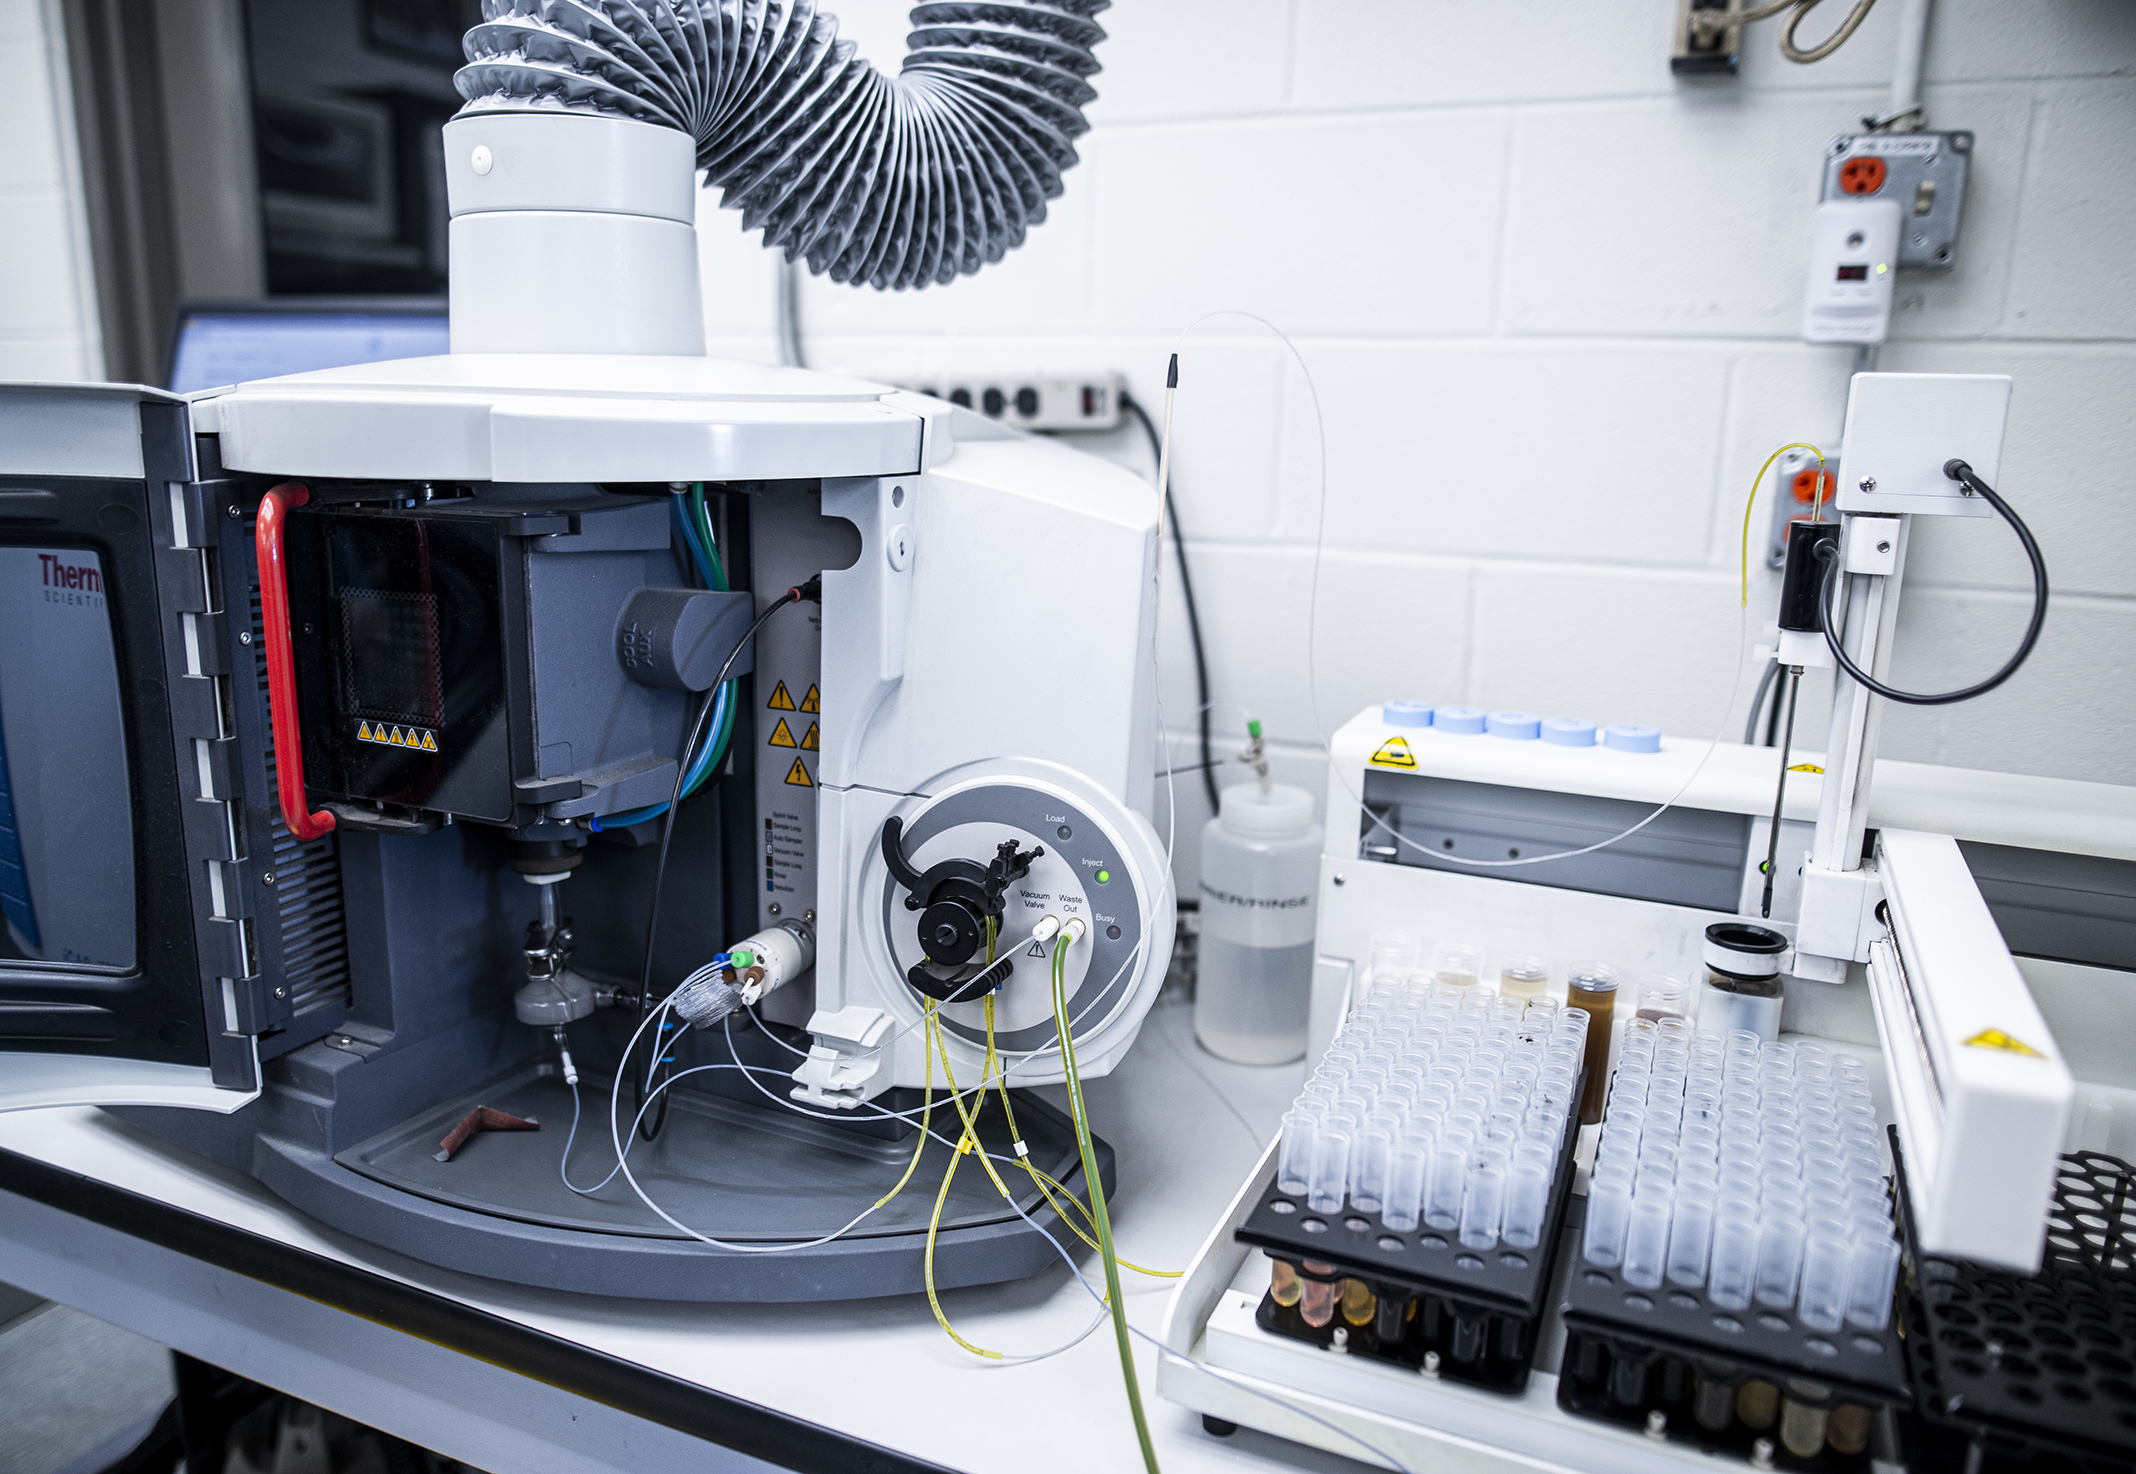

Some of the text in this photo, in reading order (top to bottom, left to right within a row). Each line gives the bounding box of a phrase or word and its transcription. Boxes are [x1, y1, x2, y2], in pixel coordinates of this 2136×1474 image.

[623, 622, 638, 669] COOL
[639, 629, 654, 667] AUX
[1045, 813, 1066, 823] Load
[773, 822, 802, 833] Sample Loop
[774, 834, 784, 842] Auto
[785, 836, 803, 844] Sampler
[774, 847, 791, 855] Vacuum
[774, 859, 803, 870] Sample Loop
[1081, 857, 1103, 868] Inject
[1020, 889, 1051, 900] Vacuum
[1058, 894, 1083, 904] Waste
[1024, 900, 1046, 910] Valve
[1063, 904, 1078, 913] Out
[1095, 913, 1116, 924] Busy
